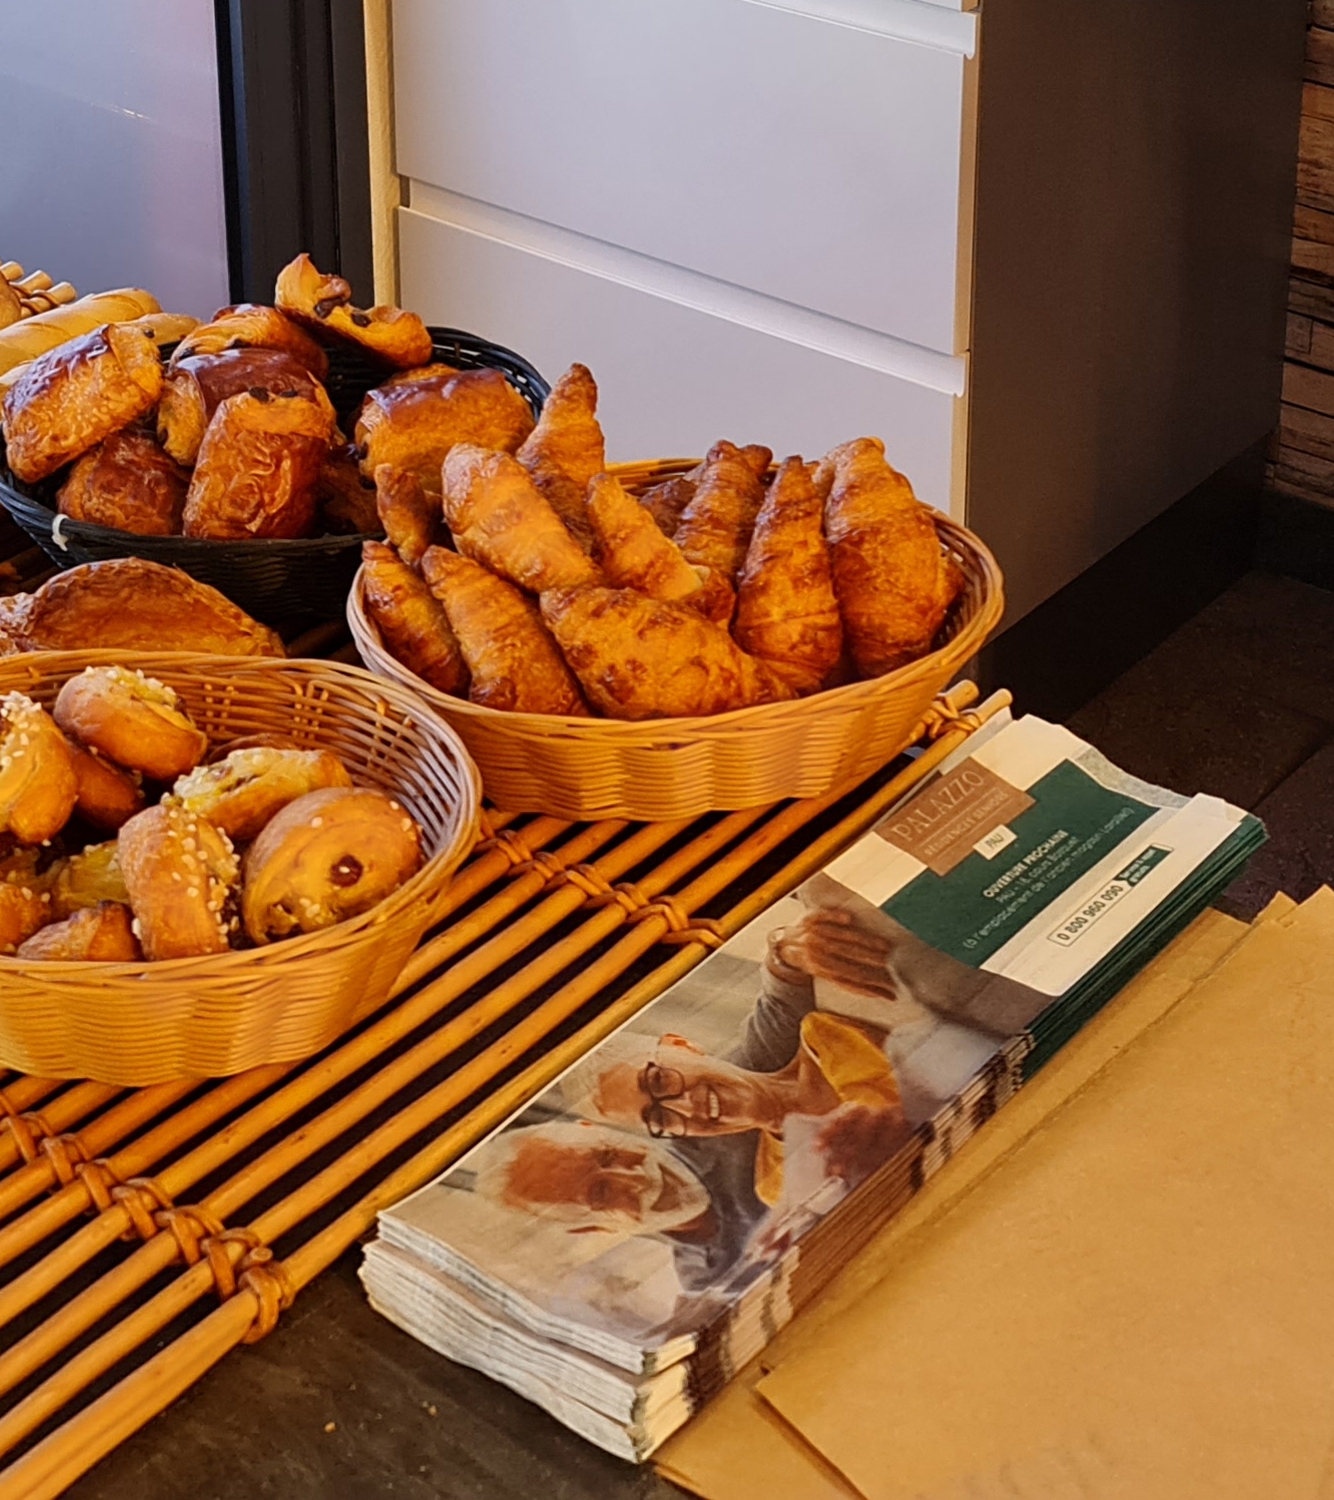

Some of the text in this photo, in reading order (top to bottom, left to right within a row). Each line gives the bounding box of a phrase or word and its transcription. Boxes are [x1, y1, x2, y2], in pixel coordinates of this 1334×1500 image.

[890, 769, 984, 842] PALAZZO
[983, 830, 1069, 898] OUVERTURE PROCHAINE
[984, 833, 1005, 850] PAU
[1056, 882, 1125, 941] 0 800 960 090
